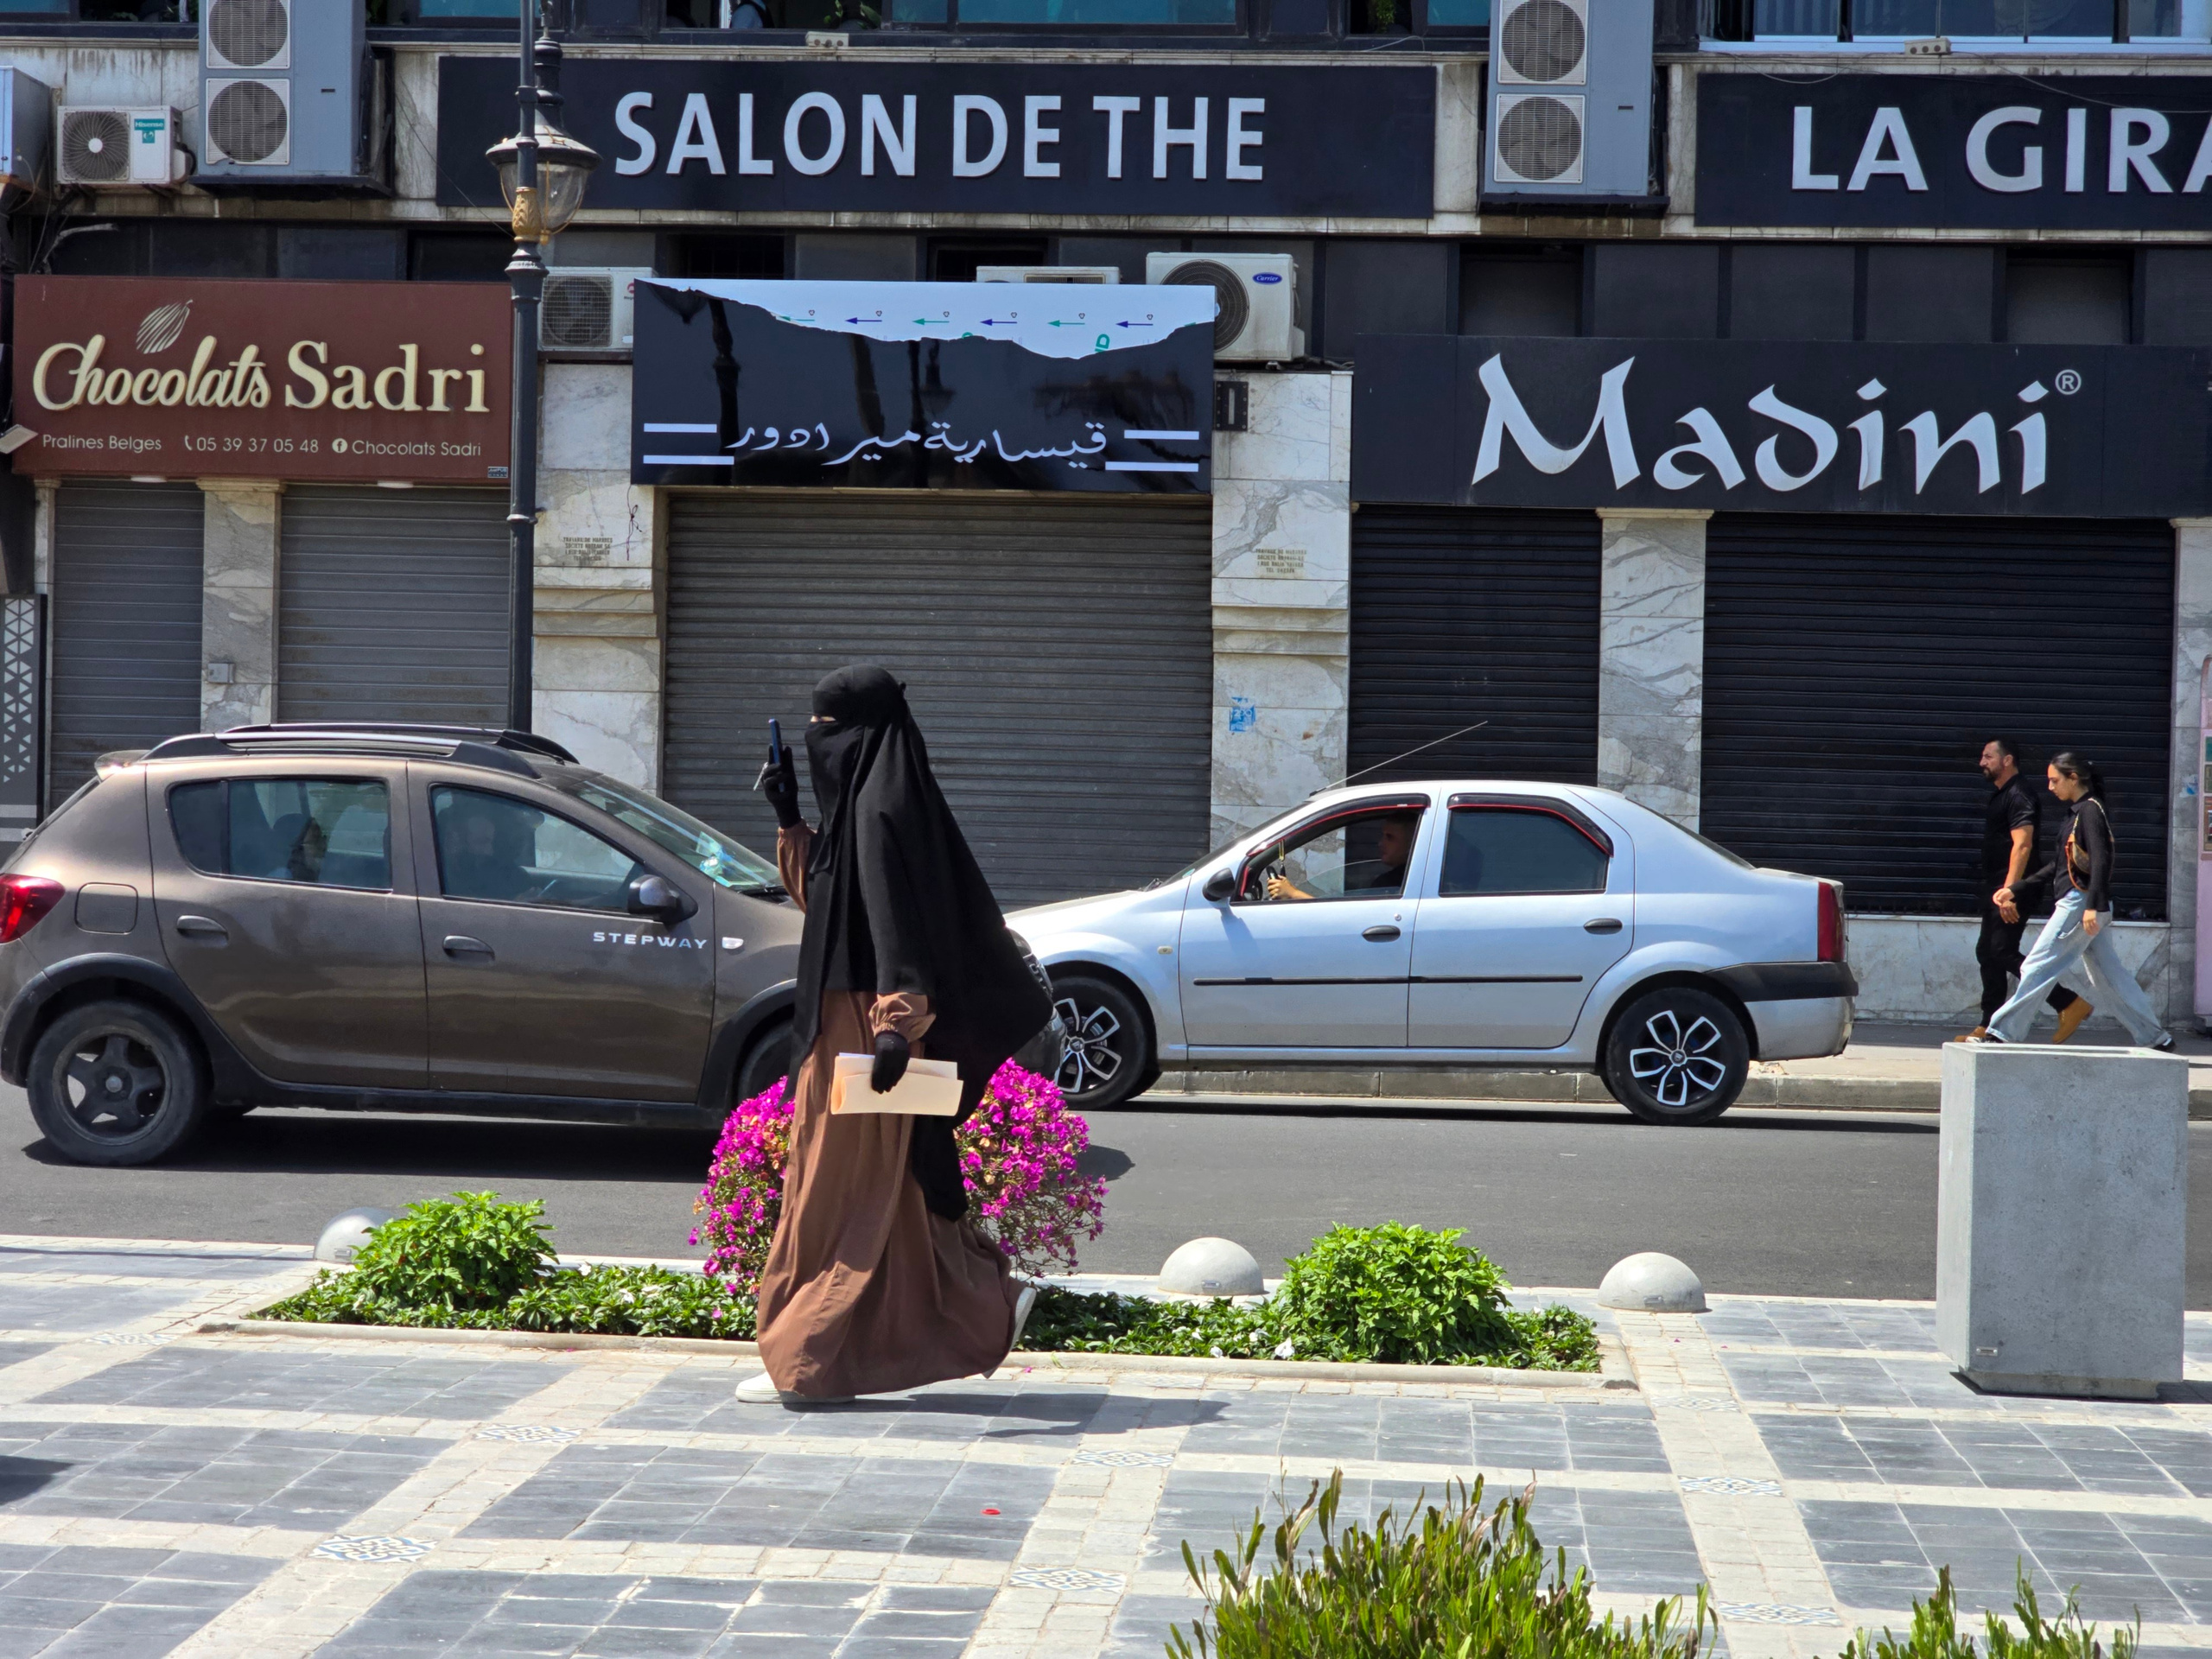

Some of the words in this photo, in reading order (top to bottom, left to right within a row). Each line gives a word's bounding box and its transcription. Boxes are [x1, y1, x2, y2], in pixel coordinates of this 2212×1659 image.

[614, 91, 918, 177] SALON
[952, 94, 1063, 178] DE
[1092, 95, 1266, 181] THE
[1791, 105, 1929, 191] LA
[33, 334, 272, 411] Chocolats
[285, 340, 490, 413] Sadri
[42, 434, 104, 449] Pralines
[109, 435, 162, 454] Belges
[196, 436, 217, 451] 05
[222, 437, 243, 452] 39
[248, 438, 268, 452] 37
[273, 438, 294, 453] 05
[299, 439, 319, 453] 48
[352, 440, 436, 455] Chocolats
[440, 442, 481, 456] Sadri
[593, 931, 708, 950] STEPWAY
